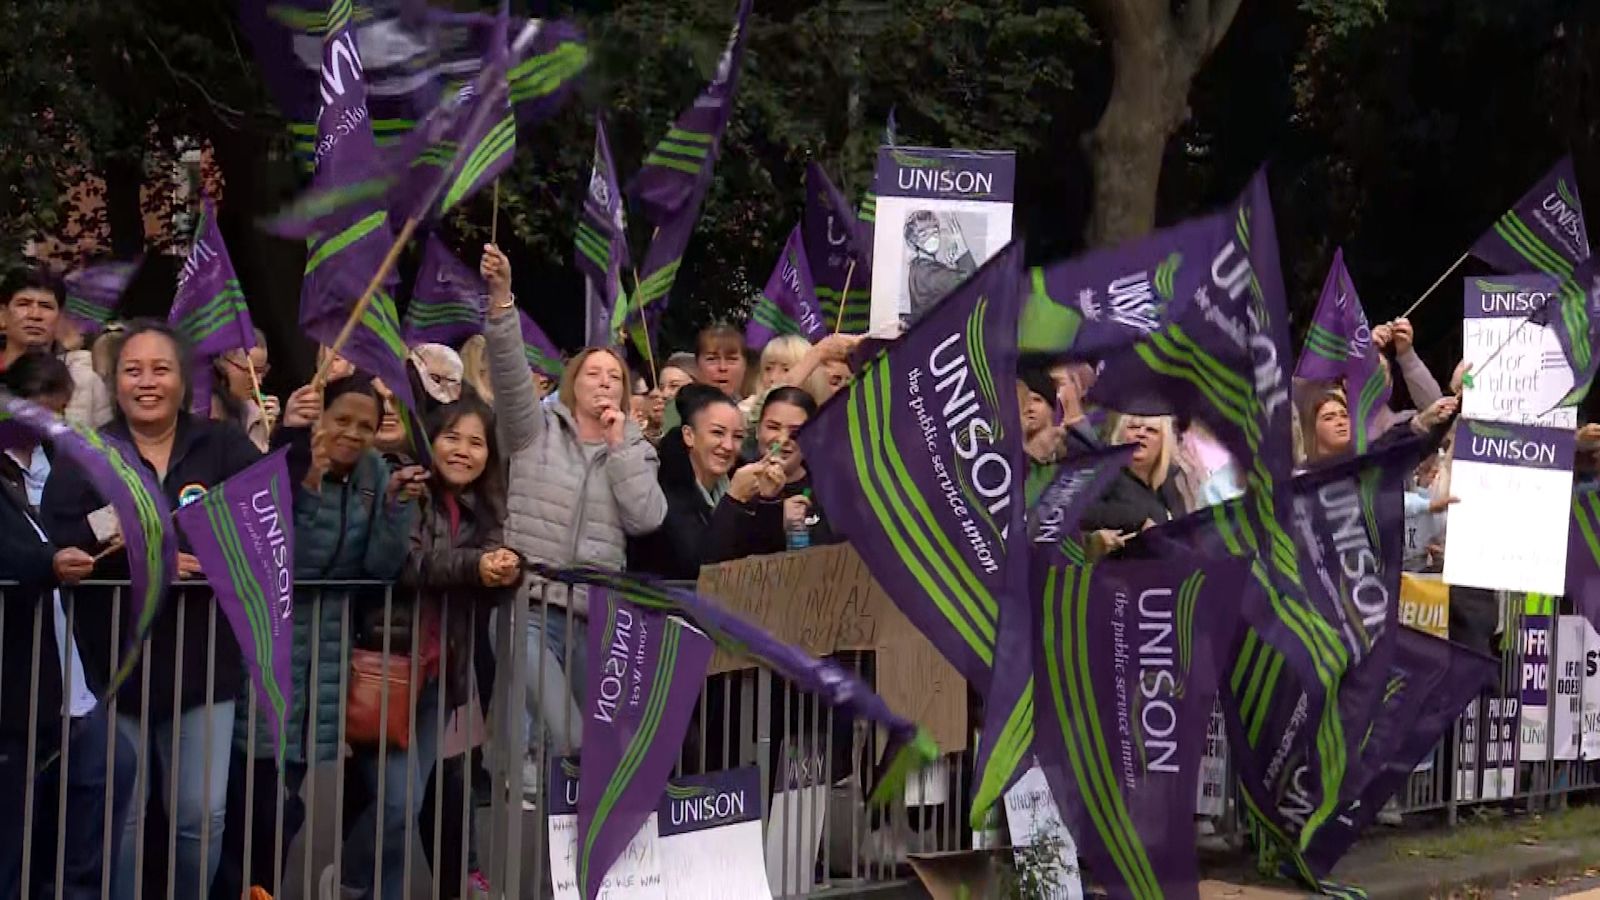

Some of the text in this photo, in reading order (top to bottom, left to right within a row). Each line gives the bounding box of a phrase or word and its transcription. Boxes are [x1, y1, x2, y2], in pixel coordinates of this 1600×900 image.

[898, 167, 993, 194] UNISON
[1481, 292, 1553, 313] UNISO
[1472, 436, 1556, 464] UNISON
[908, 367, 999, 575] the public service union
[252, 489, 293, 620] UNISON
[1400, 601, 1447, 628] BUIL
[1111, 592, 1136, 789] the public service union
[1138, 587, 1180, 773] UNISON
[671, 790, 744, 825] UNISON
[640, 873, 661, 887] WAN
